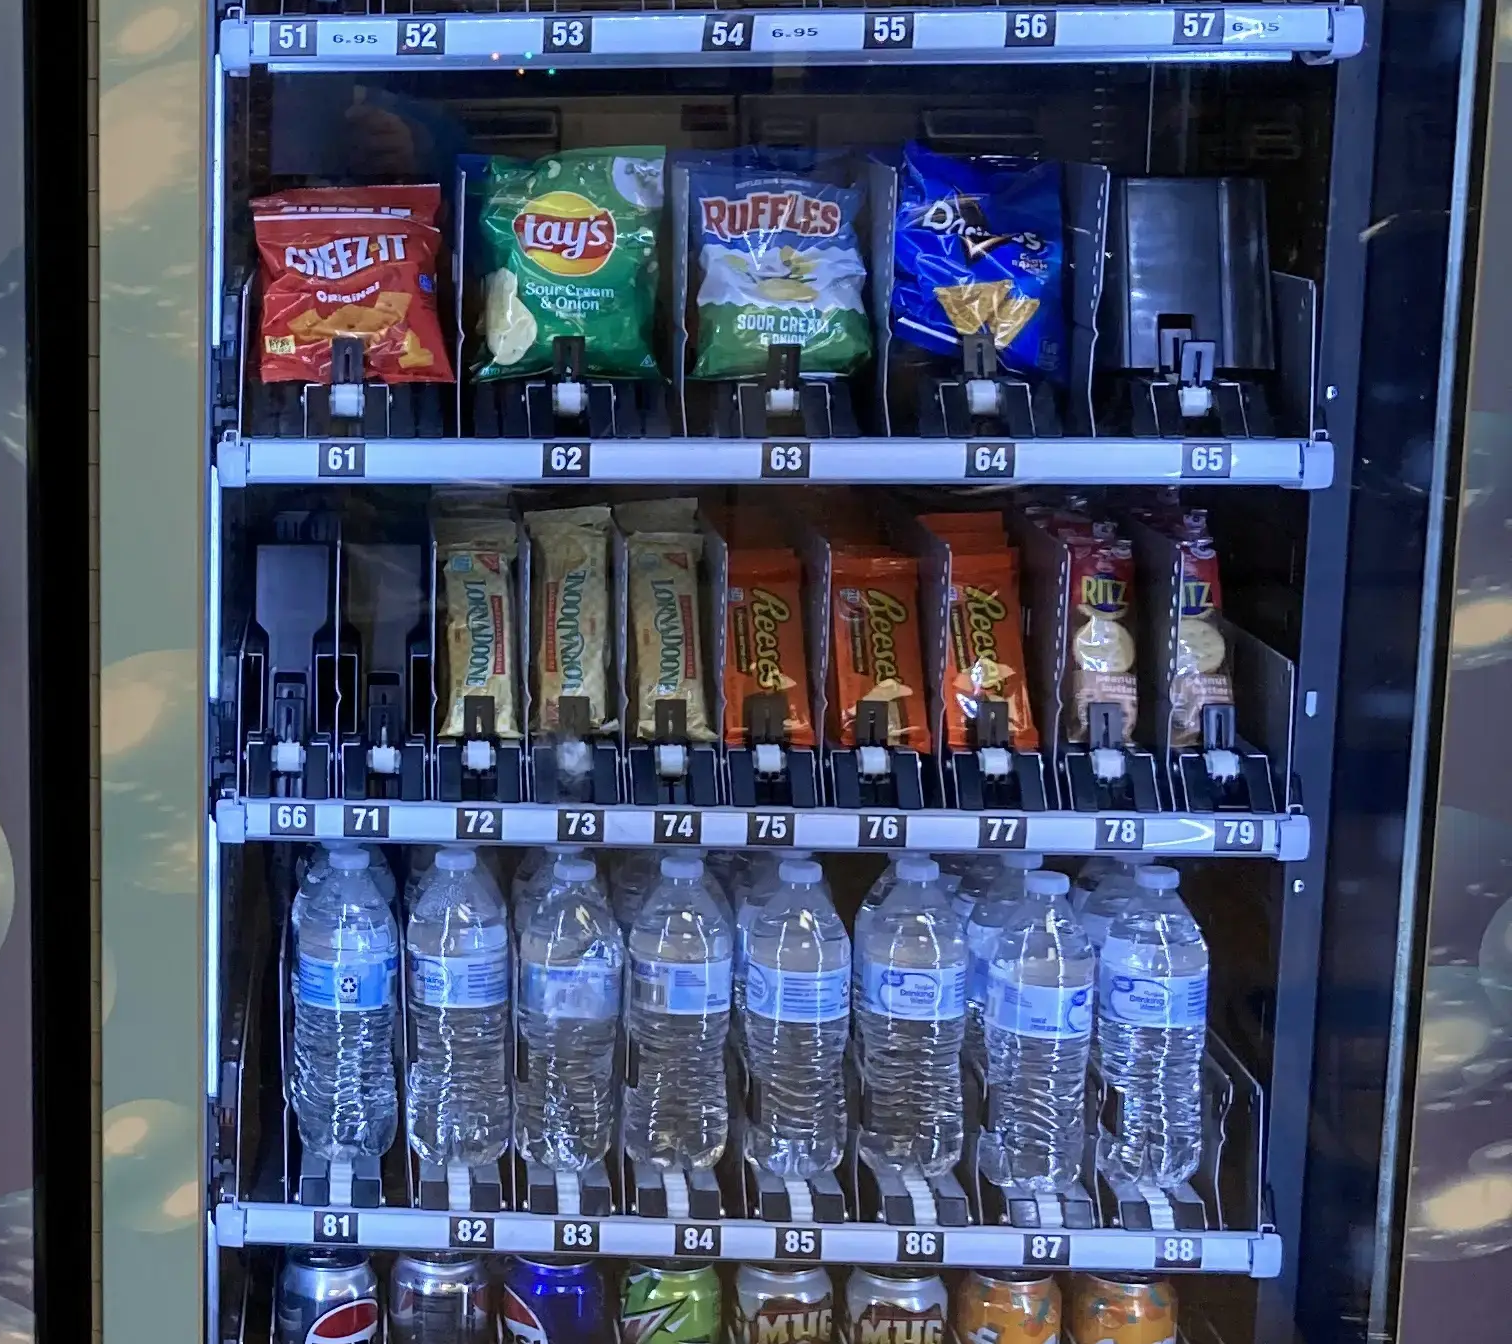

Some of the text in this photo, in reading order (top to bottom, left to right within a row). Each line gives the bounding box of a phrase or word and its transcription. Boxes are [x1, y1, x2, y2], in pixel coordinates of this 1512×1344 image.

[405, 24, 437, 48] 52
[552, 22, 584, 46] 53
[712, 22, 744, 47] 54
[772, 27, 818, 39] 6.95
[873, 17, 905, 42] 55
[1015, 14, 1047, 39] 56
[1183, 12, 1216, 37] 57
[279, 25, 307, 48] 51
[332, 33, 378, 44] 6.95
[700, 192, 840, 241] RUFFLES
[524, 214, 608, 260] Lay's
[525, 282, 614, 298] Sour Cream
[540, 296, 599, 311] & Onion
[737, 314, 830, 335] SOUR CREAM
[328, 447, 355, 470] 61
[551, 447, 581, 470] 62
[771, 447, 801, 471] 63
[975, 447, 1007, 471] 64
[1192, 447, 1223, 471] 65
[1080, 575, 1129, 606] RITZ
[277, 806, 306, 828] 66
[352, 807, 378, 830] 71
[464, 810, 494, 833] 72
[566, 813, 595, 836] 73
[663, 815, 693, 838] 74
[757, 815, 787, 838] 75
[868, 816, 898, 839] 76
[988, 818, 1018, 841] 77
[1105, 819, 1136, 842] 78
[1224, 821, 1254, 843] 79
[323, 1214, 349, 1236] 81
[457, 1219, 486, 1242] 82
[563, 1223, 592, 1246] 83
[683, 1228, 713, 1251] 84
[785, 1231, 814, 1254] 85
[905, 1233, 935, 1256] 86
[1031, 1235, 1061, 1259] 87
[1164, 1238, 1194, 1261] 88
